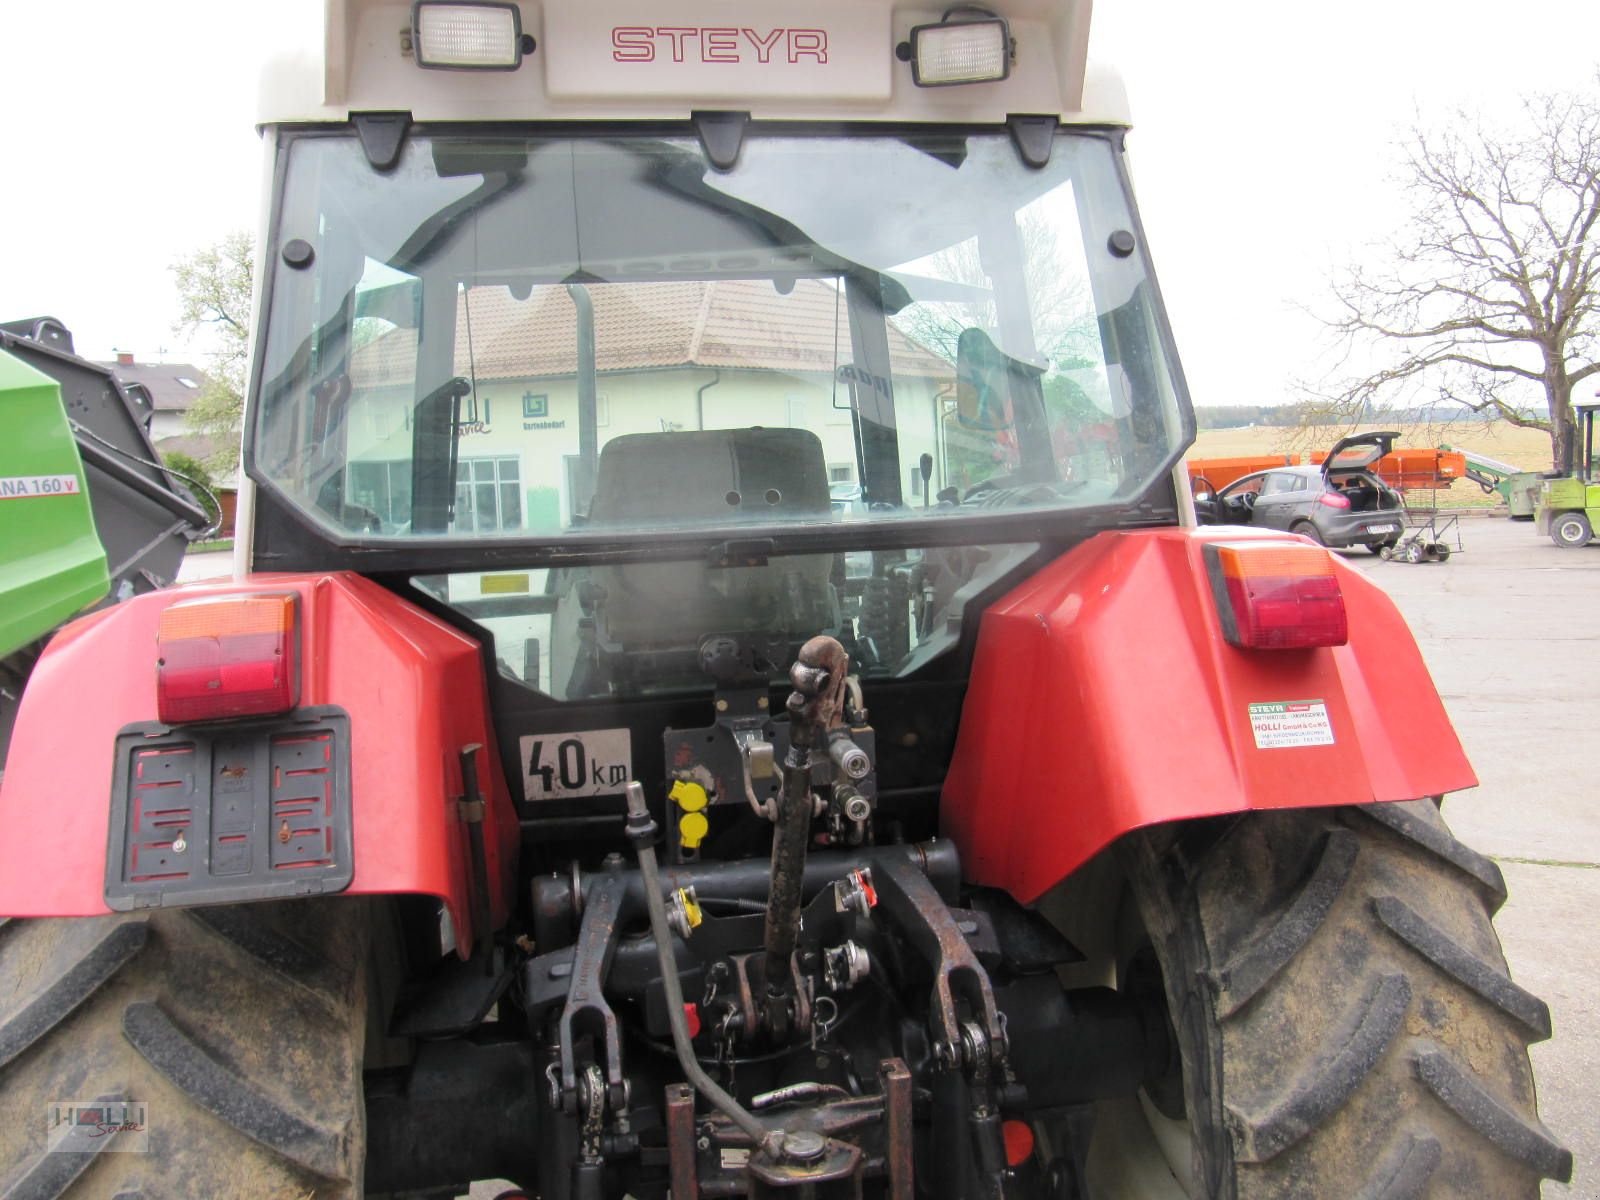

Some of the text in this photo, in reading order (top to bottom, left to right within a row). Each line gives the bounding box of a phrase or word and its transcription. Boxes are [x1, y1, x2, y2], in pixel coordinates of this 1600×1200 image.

[612, 27, 828, 64] STEYR
[31, 478, 62, 493] 160
[1249, 704, 1284, 713] STEYR
[1254, 722, 1281, 732] HOLLI
[528, 739, 627, 792] 40 km
